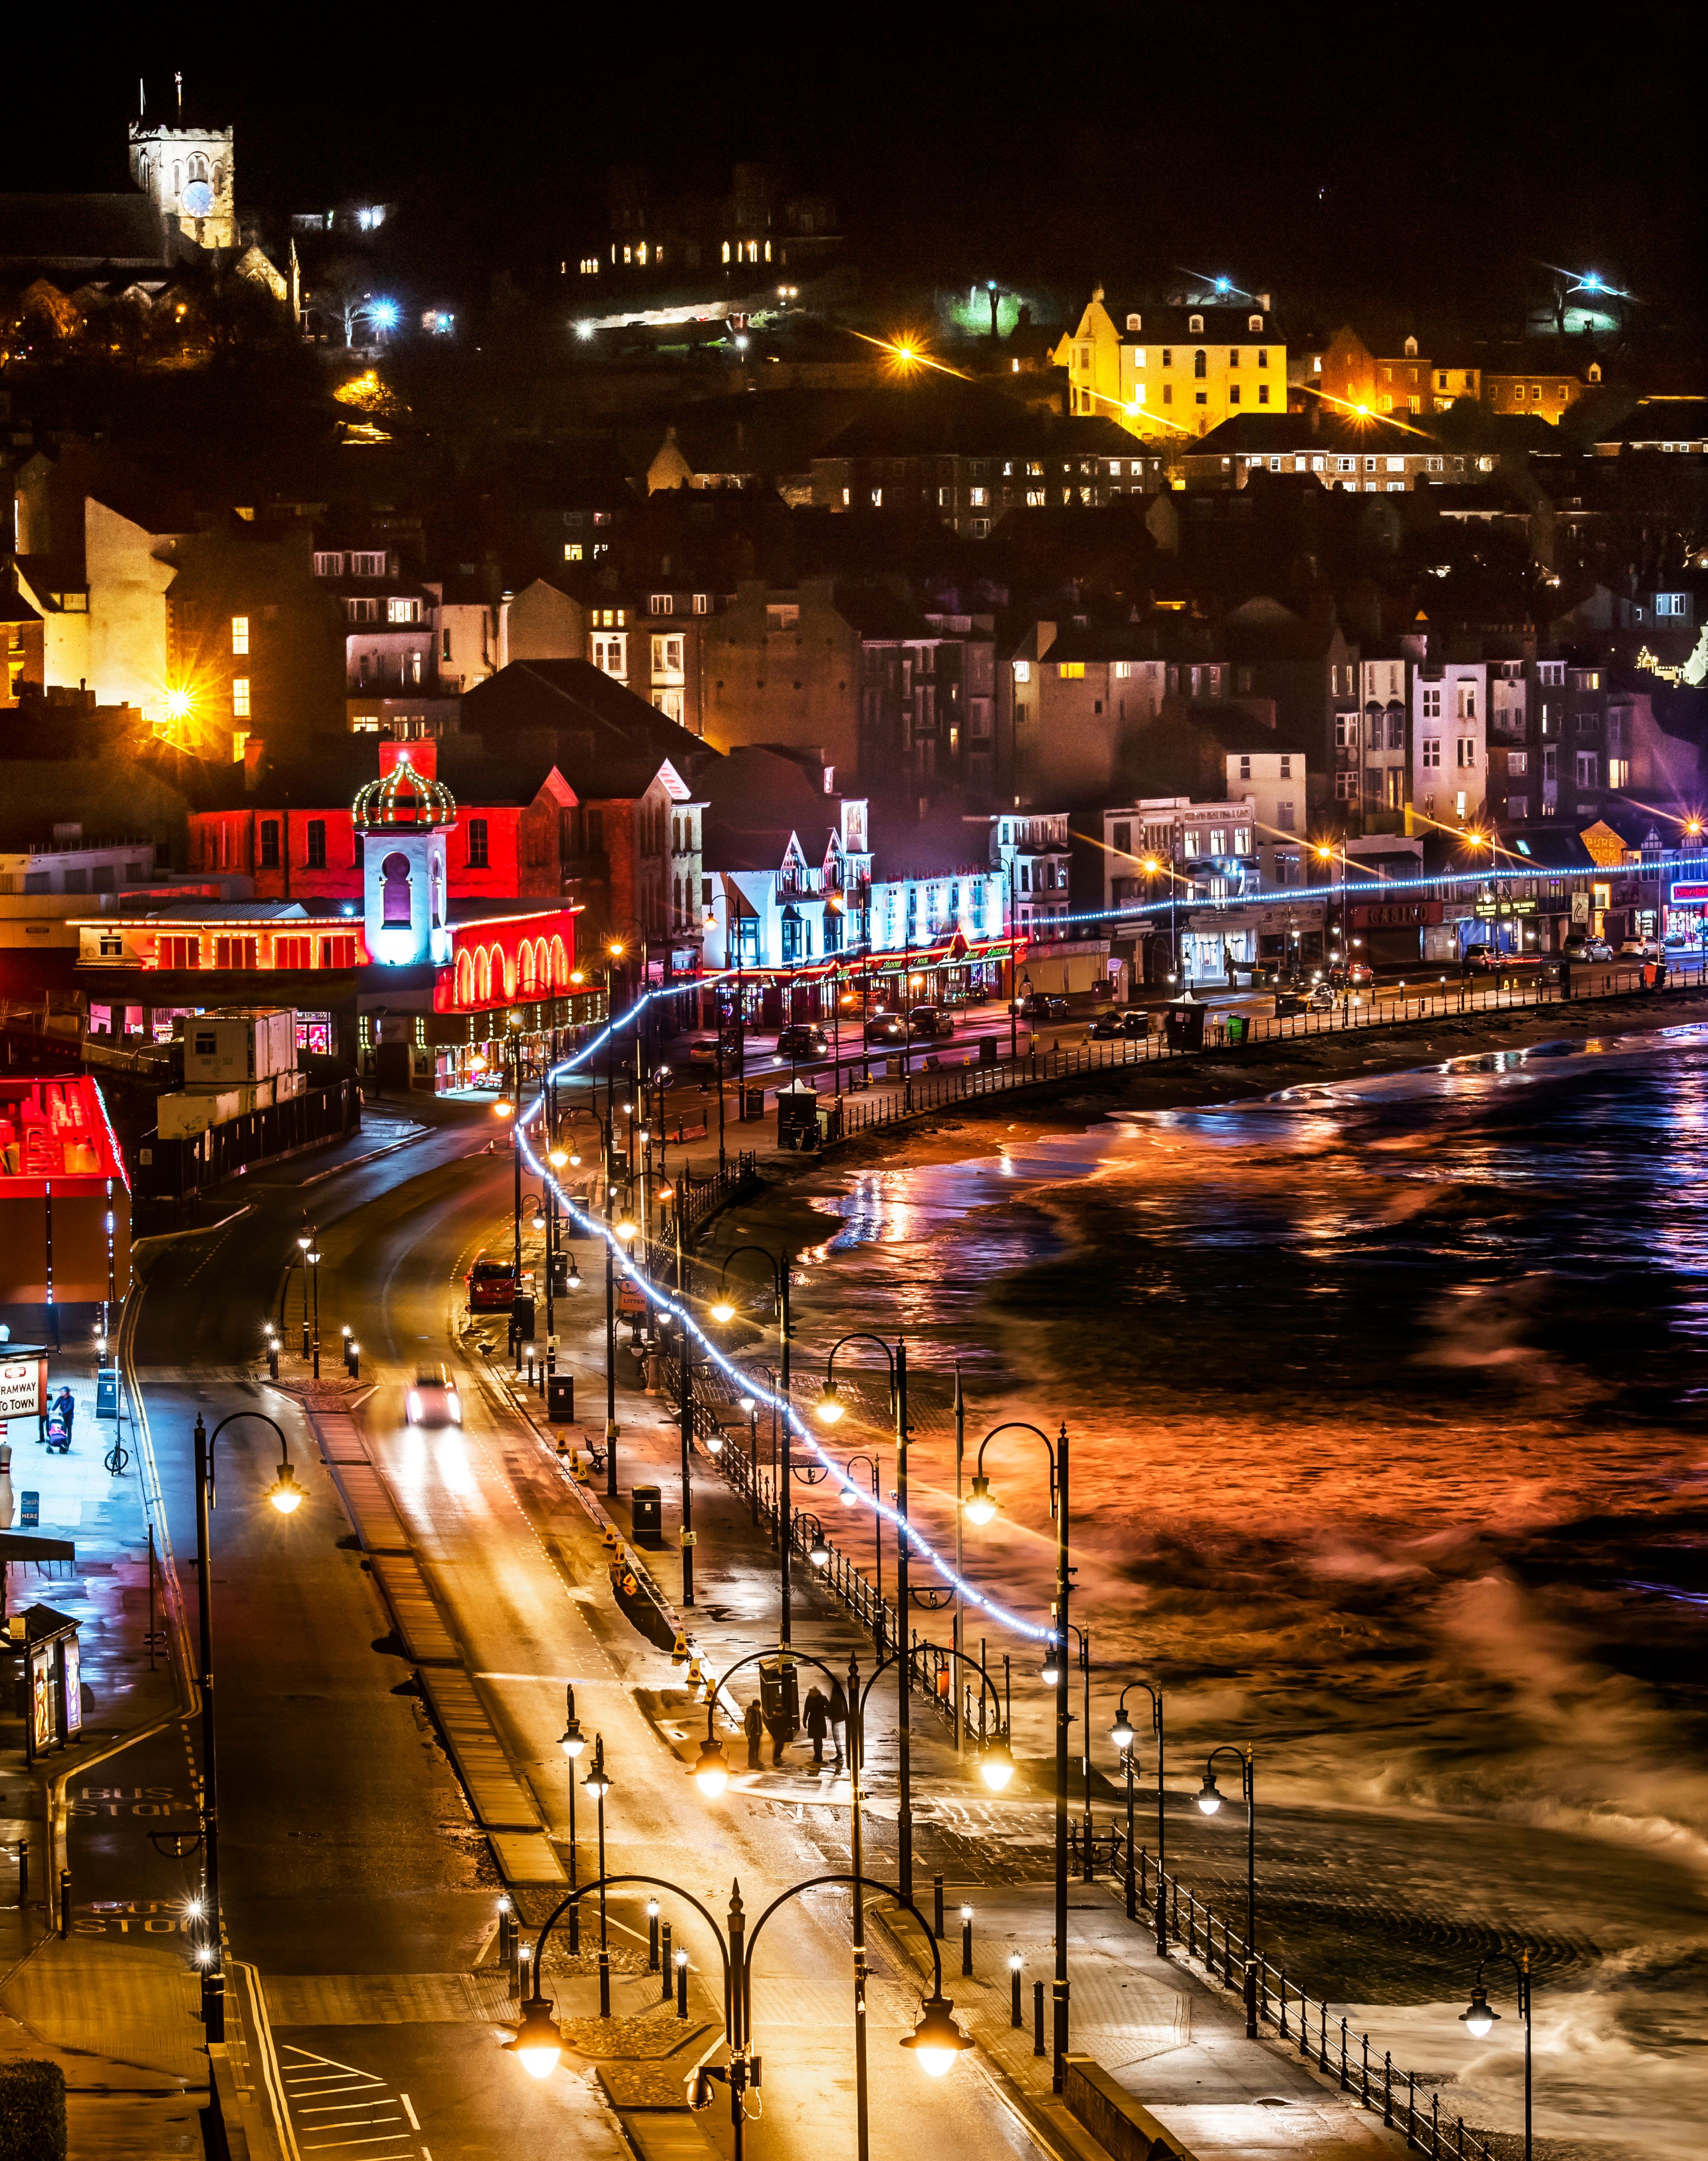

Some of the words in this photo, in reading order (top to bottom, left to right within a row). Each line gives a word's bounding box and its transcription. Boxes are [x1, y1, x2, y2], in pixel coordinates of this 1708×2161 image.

[1369, 906, 1428, 923] CASINO
[0, 1382, 36, 1395] RAMWAY
[10, 1398, 34, 1410] TOWN
[82, 1787, 174, 1799] BUS
[70, 1803, 193, 1816] STOP
